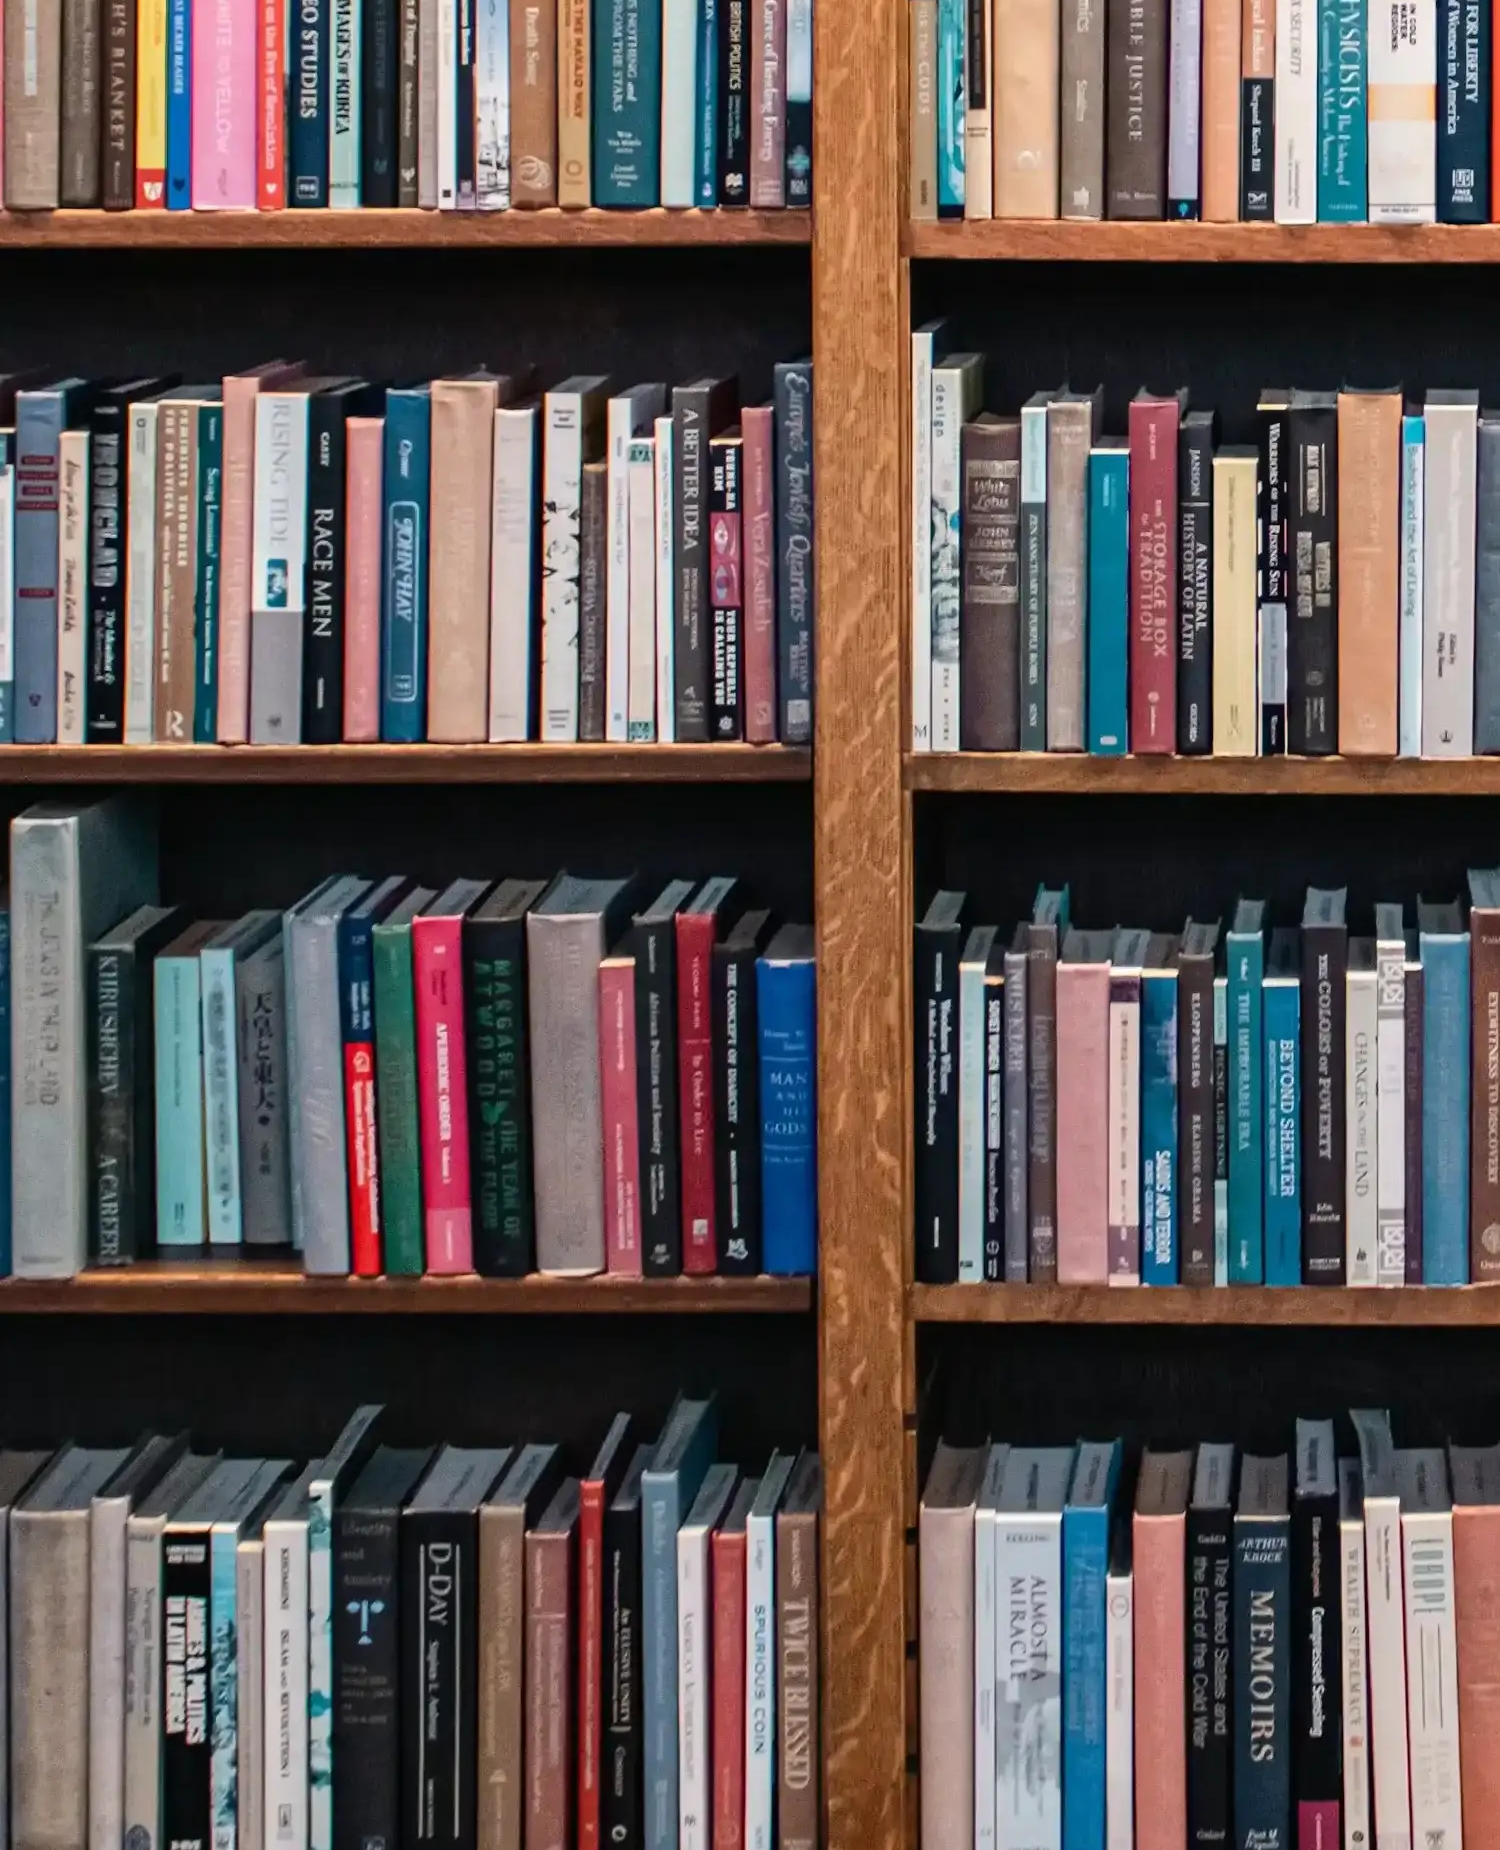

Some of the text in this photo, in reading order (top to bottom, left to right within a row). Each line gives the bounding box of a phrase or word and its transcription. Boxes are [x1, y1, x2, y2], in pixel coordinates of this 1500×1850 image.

[729, 2, 742, 41] BRITISH
[729, 43, 743, 90] POLITICS
[1448, 10, 1459, 59] Women
[1448, 63, 1459, 76] in
[1465, 6, 1479, 34] FOR
[1465, 39, 1479, 103] LIBERTY
[111, 48, 124, 150] BLANKET
[300, 30, 317, 118] STUDIES
[336, 79, 350, 134] KOREA
[1125, 55, 1143, 141] JUSTICE
[1447, 80, 1459, 134] America
[933, 385, 946, 438] design
[683, 409, 699, 550] A BETTER IDEA
[784, 372, 809, 622] Europe's Jewish Quarters
[1190, 450, 1200, 496] JANSON
[313, 509, 333, 637] RACE MEN
[1181, 514, 1196, 660] HISTORY OF LATIN
[1195, 542, 1207, 630] A NATURAL
[1280, 1040, 1294, 1196] BEYOND SHELTER
[1319, 981, 1331, 1160] COLORS POVERTY
[427, 1542, 451, 1625] D-DAY
[1010, 1577, 1026, 1682] MIRACLE
[1030, 1575, 1047, 1682] ALMOST A
[754, 1605, 766, 1753] SPURIOUS COIN
[783, 1597, 809, 1789] TWICE BLESSED
[1193, 1557, 1208, 1748] the End of the Cold War
[1214, 1558, 1228, 1735] The United States and
[1249, 1590, 1274, 1762] MEMOIRS
[1309, 1607, 1325, 1738] Compressed Sensing
